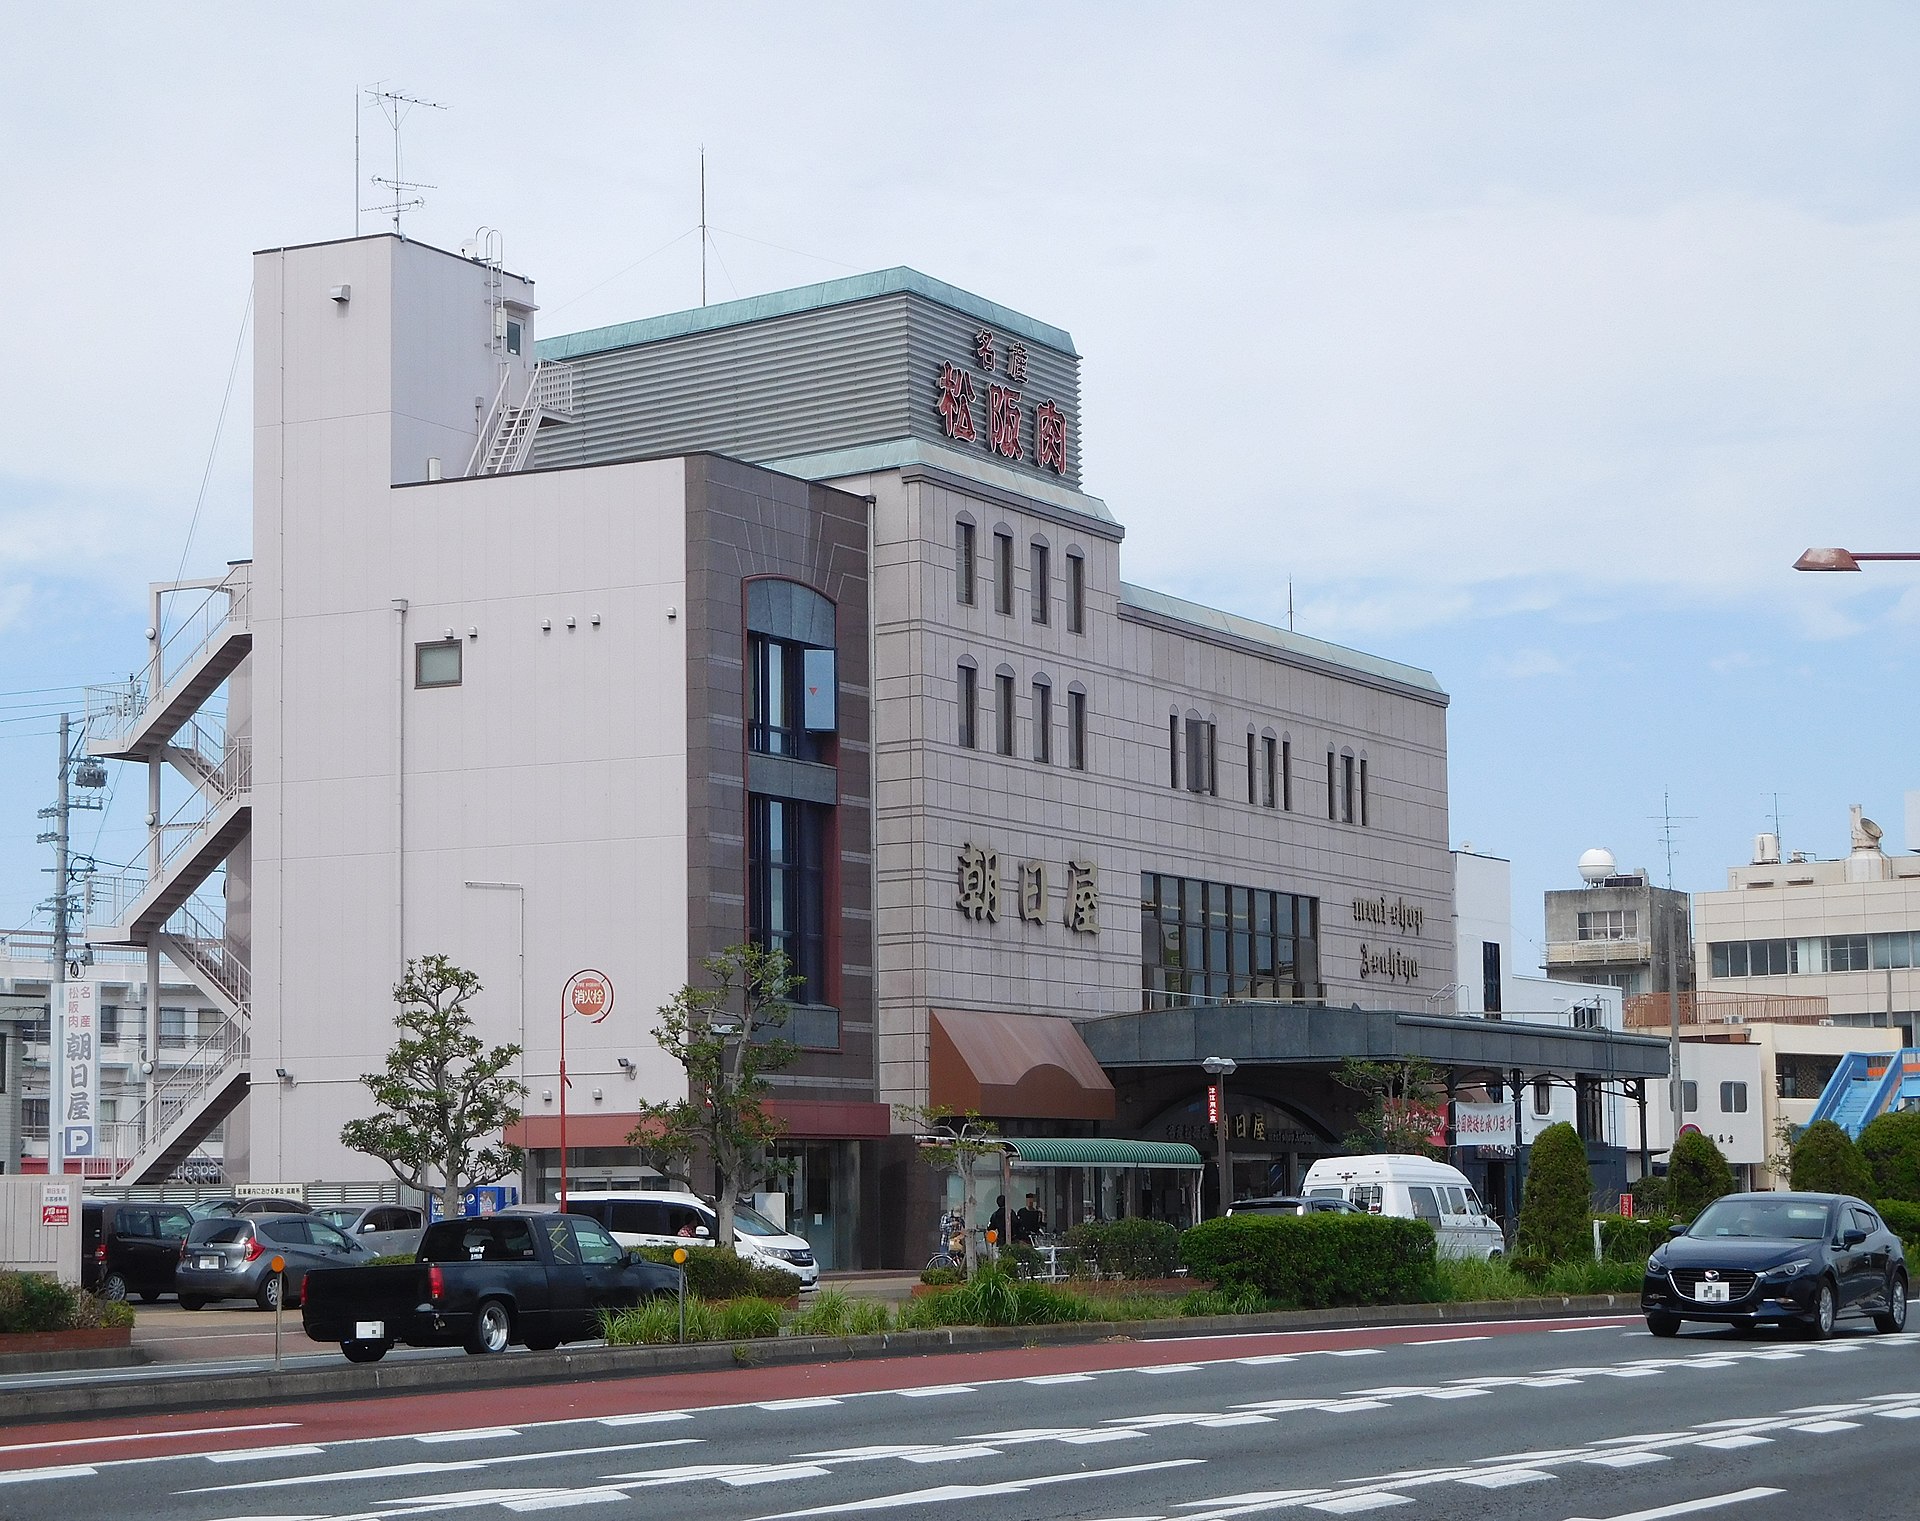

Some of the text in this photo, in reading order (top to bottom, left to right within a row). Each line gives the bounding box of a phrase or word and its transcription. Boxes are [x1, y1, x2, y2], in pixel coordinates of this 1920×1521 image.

[975, 329, 1029, 384] 名産
[938, 360, 1067, 475] 松阪肉
[956, 841, 1100, 934] 朝日屋
[68, 986, 79, 1028] 松阪肉
[574, 989, 604, 1005] 消火栓
[66, 1032, 91, 1121] 朝日屋
[70, 1130, 89, 1152] P
